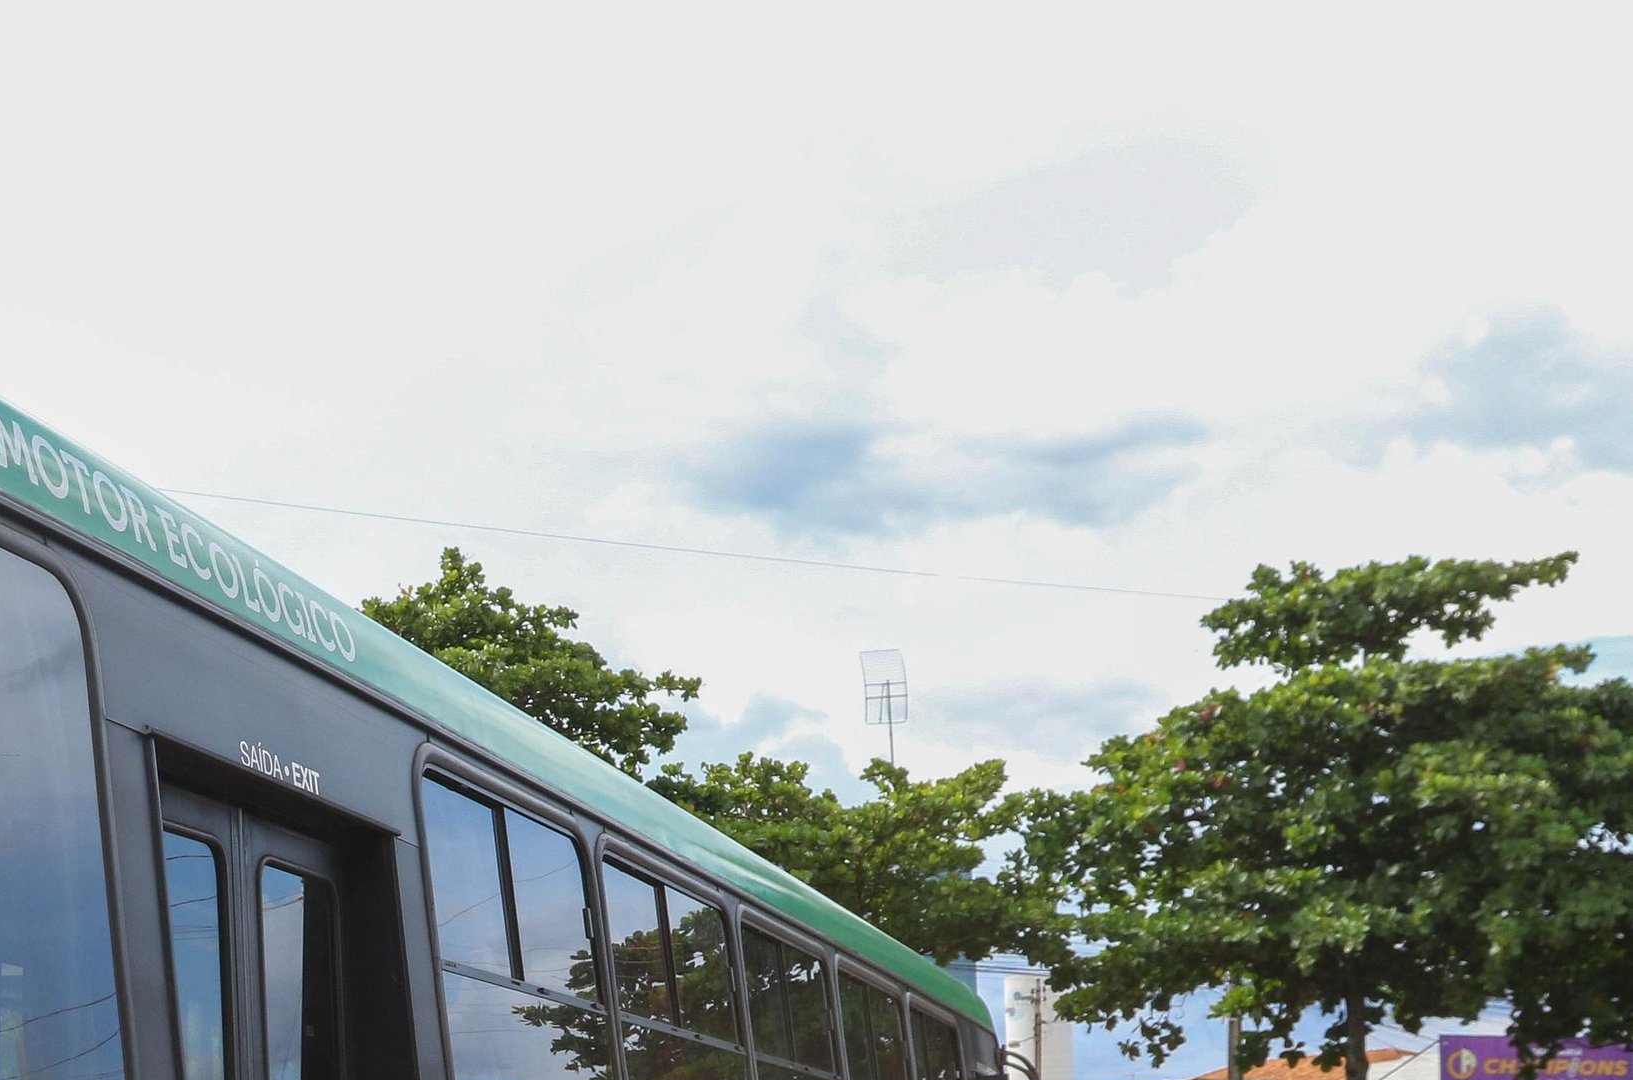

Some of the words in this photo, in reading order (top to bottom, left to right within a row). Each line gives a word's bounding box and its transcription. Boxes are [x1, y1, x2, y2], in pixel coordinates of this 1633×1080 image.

[240, 740, 284, 780] SAÍDA
[291, 761, 320, 796] EXIT
[1483, 1057, 1629, 1078] CHPIONS
